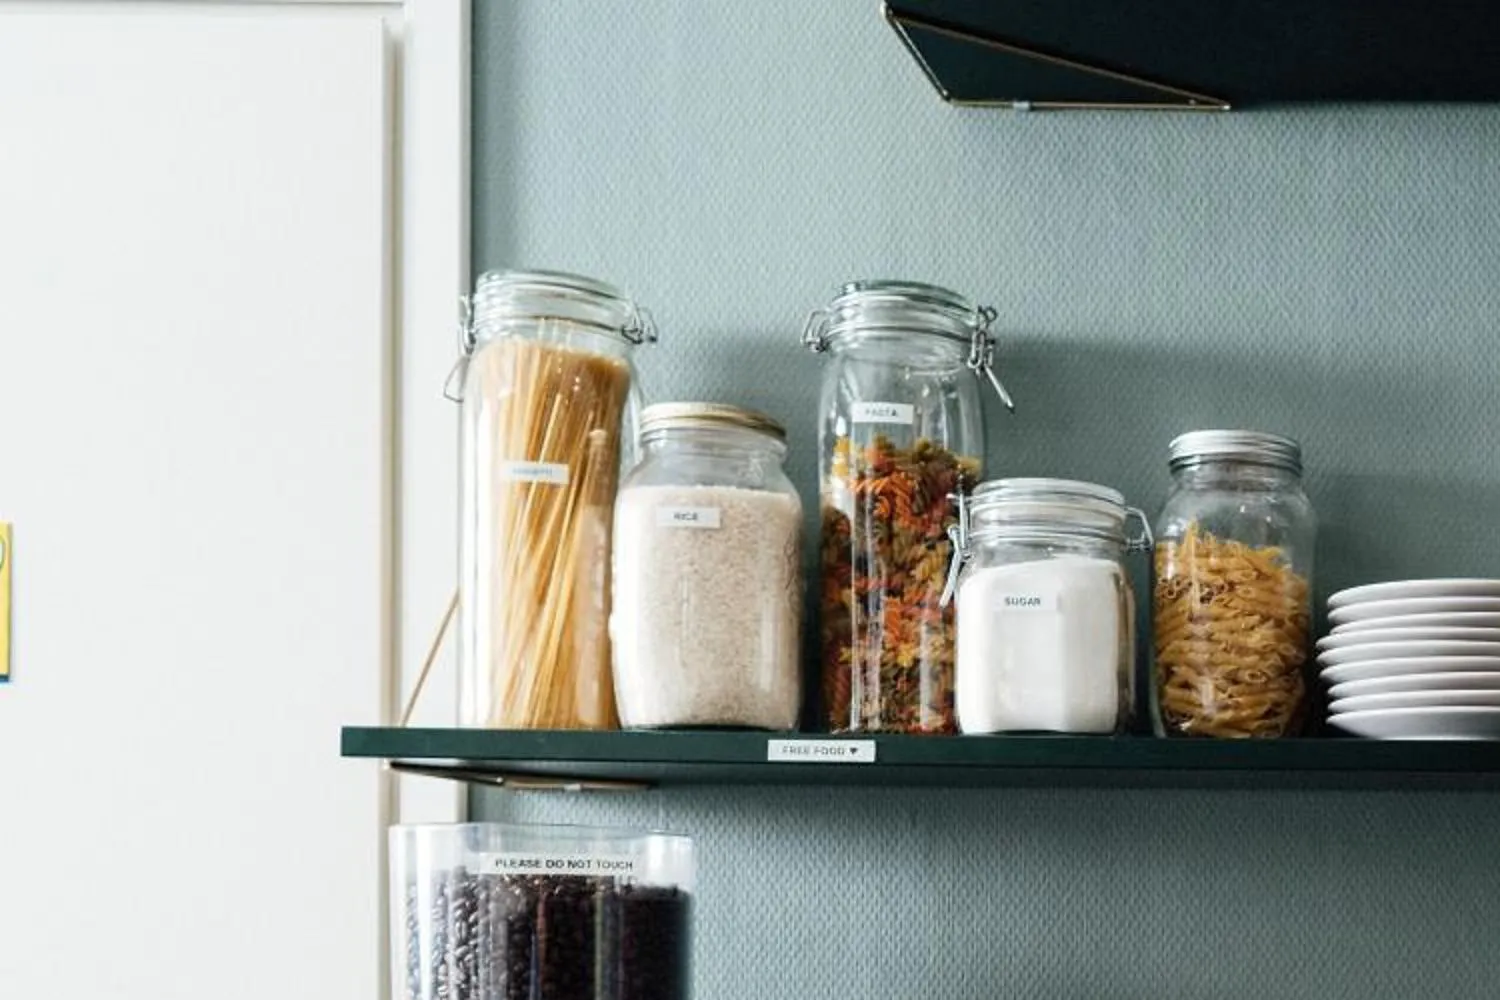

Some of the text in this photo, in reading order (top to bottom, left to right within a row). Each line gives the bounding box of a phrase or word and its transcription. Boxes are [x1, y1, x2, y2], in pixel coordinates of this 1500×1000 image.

[1004, 595, 1041, 606] SUGAR
[782, 745, 845, 756] FREE FOOD
[495, 858, 634, 870] PLEASE DO NOT TOUCH
